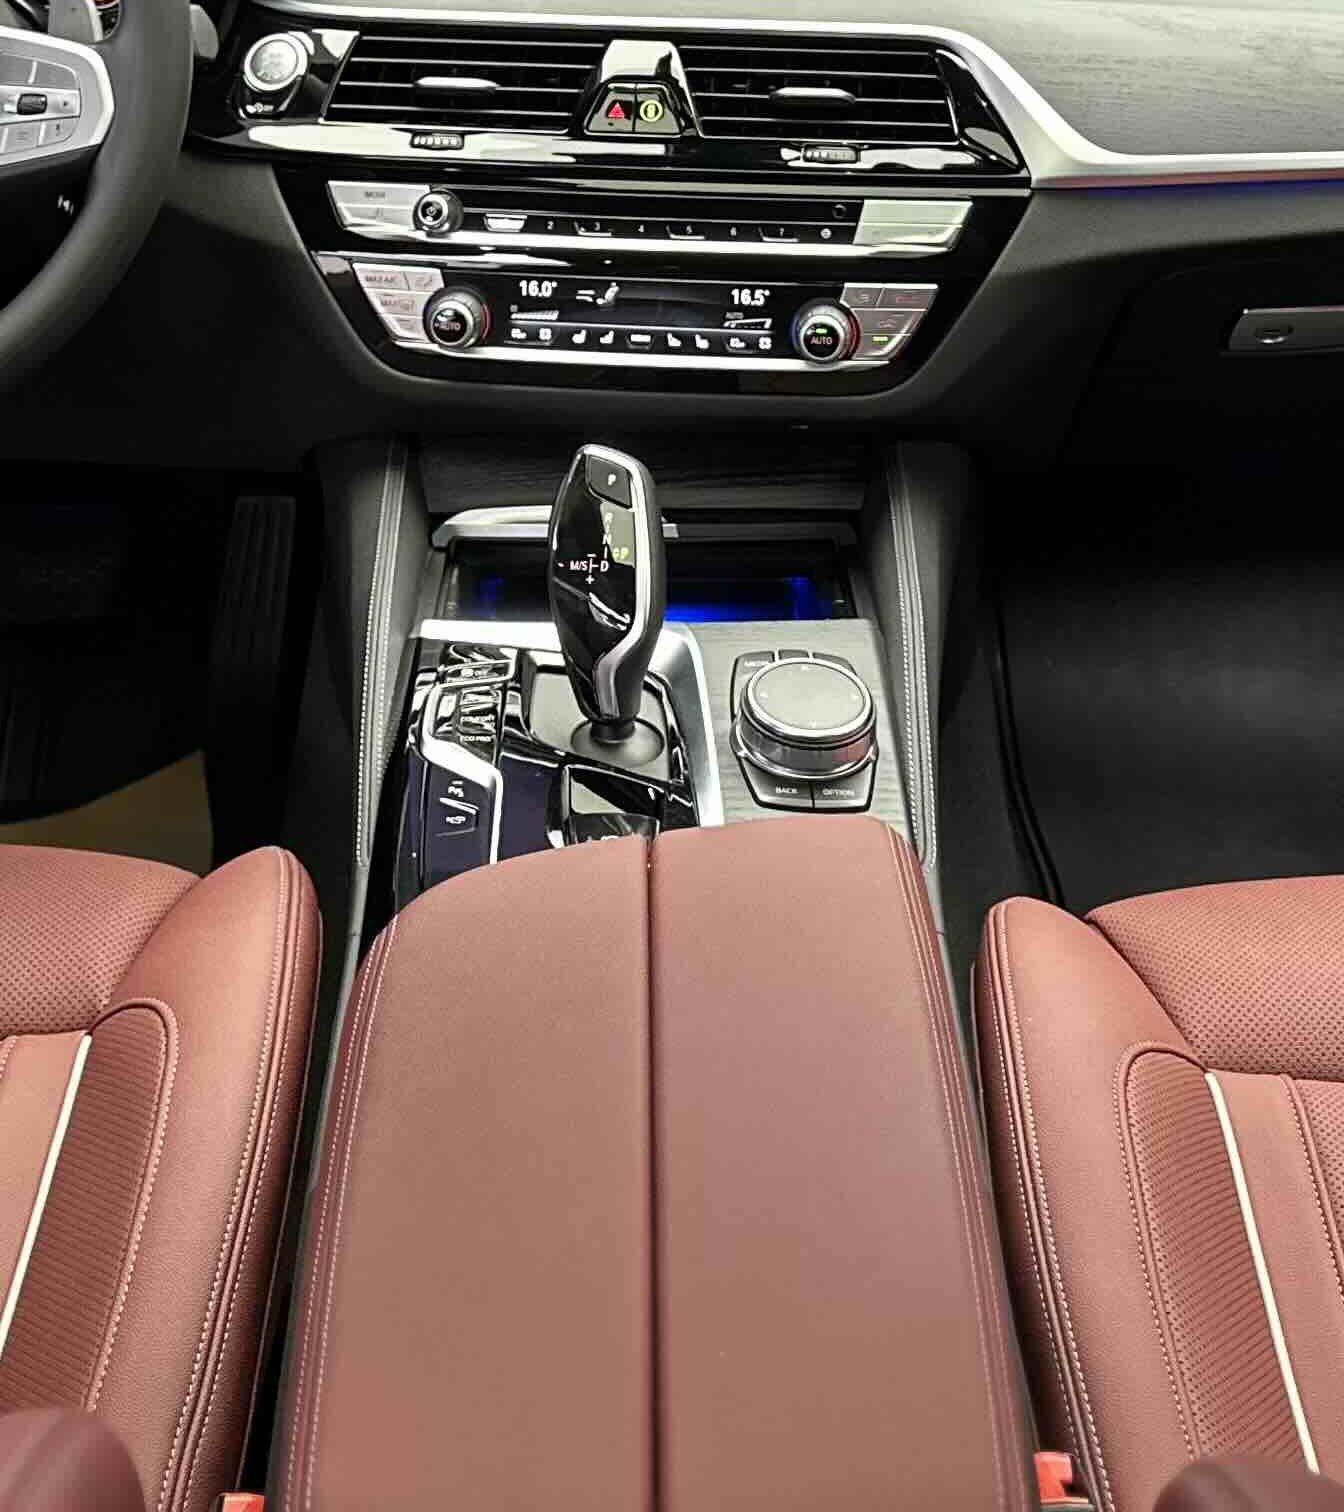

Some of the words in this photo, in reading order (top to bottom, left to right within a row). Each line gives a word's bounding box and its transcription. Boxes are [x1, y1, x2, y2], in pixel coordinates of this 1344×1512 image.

[519, 280, 558, 298] 16.0°
[731, 288, 771, 307] 16.5°
[810, 336, 833, 345] AUTO
[607, 473, 617, 486] P
[569, 560, 588, 571] M/S
[600, 561, 609, 572] D
